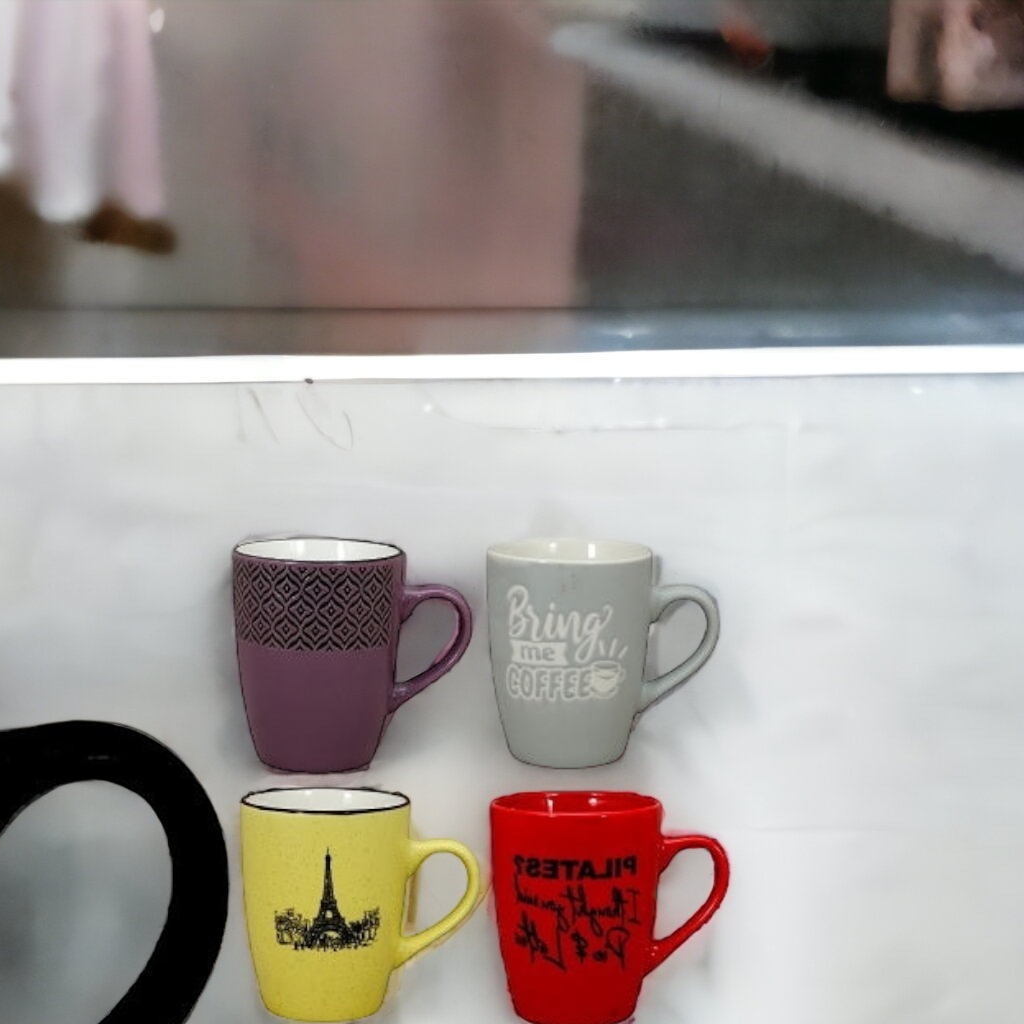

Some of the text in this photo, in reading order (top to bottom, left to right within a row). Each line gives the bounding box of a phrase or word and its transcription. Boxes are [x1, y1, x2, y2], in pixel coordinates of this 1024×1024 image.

[507, 584, 614, 663] Bring
[521, 645, 555, 662] me
[506, 663, 593, 701] COFFEE
